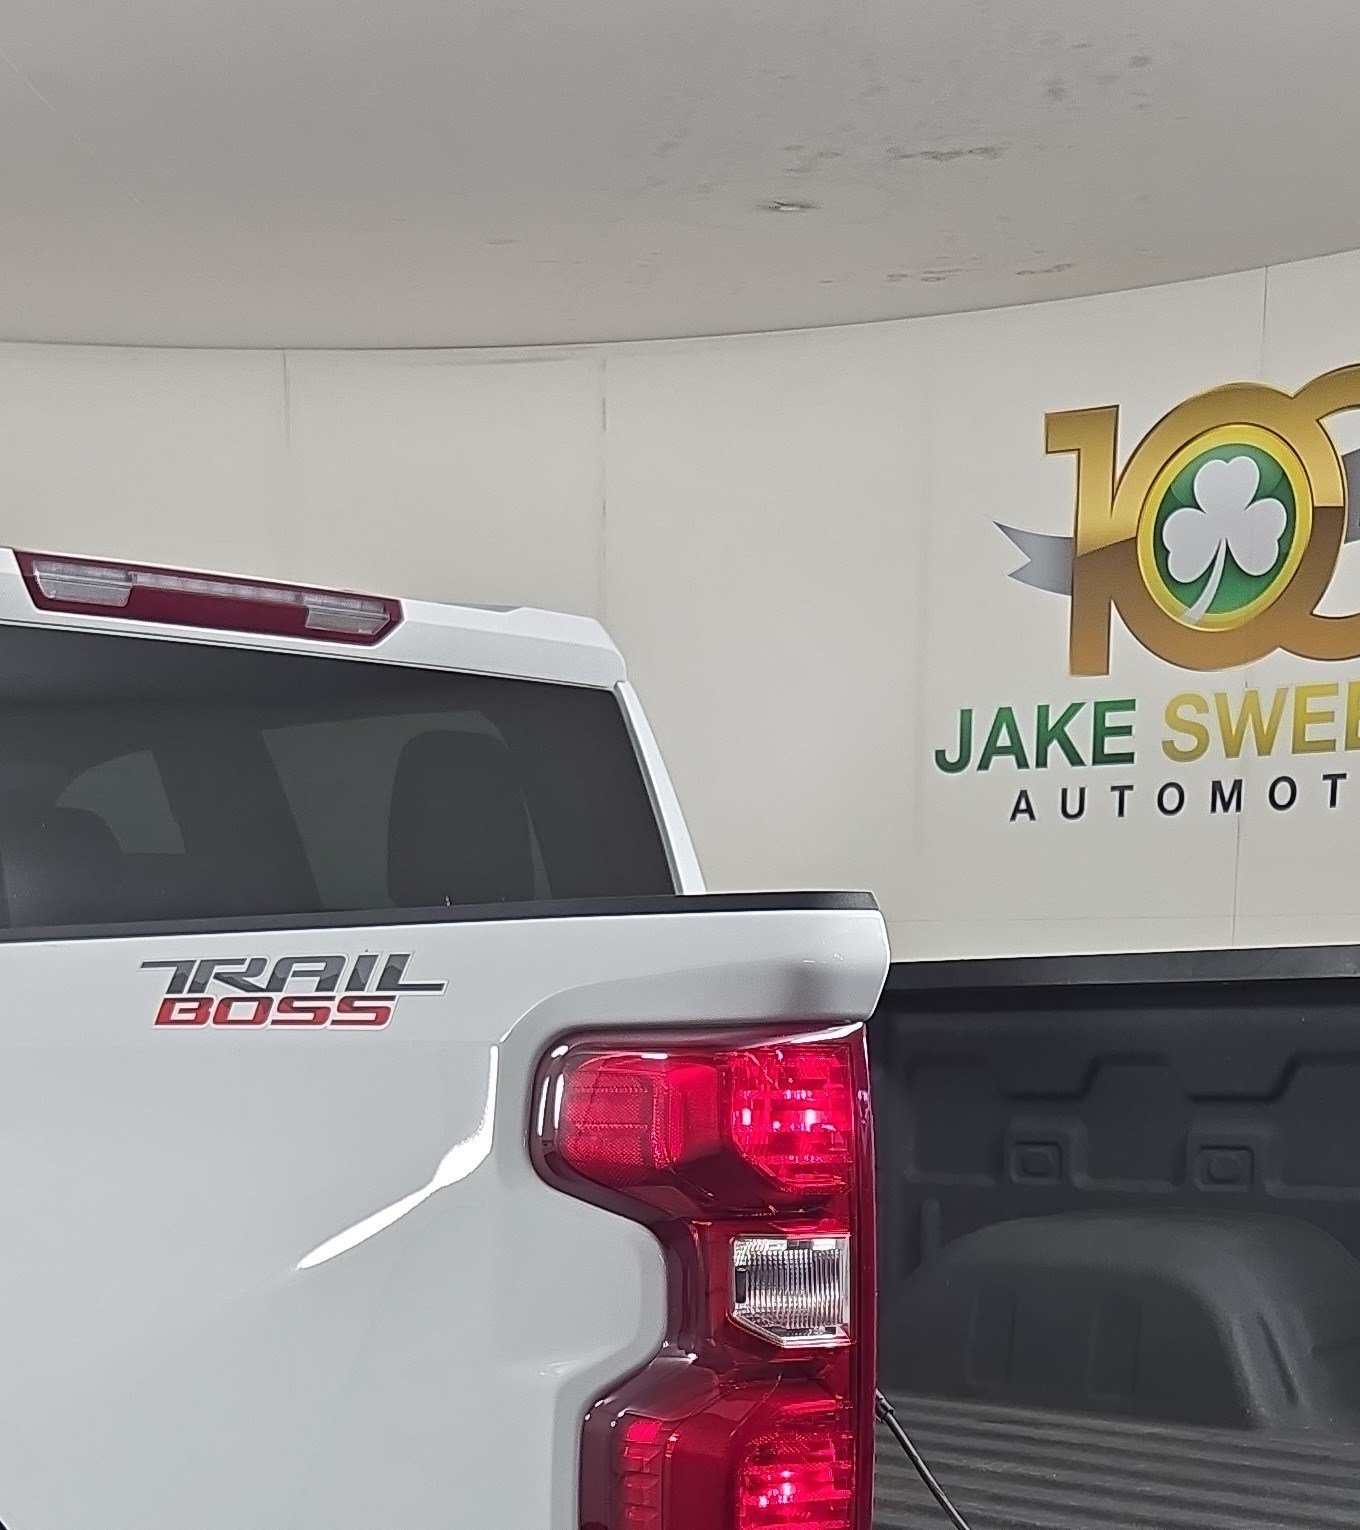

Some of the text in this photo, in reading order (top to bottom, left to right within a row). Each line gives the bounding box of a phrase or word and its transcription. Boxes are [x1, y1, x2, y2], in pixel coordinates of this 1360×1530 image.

[935, 699, 1137, 774] JAKE
[139, 952, 448, 995] TRAIL
[154, 994, 397, 1028] BOSS
